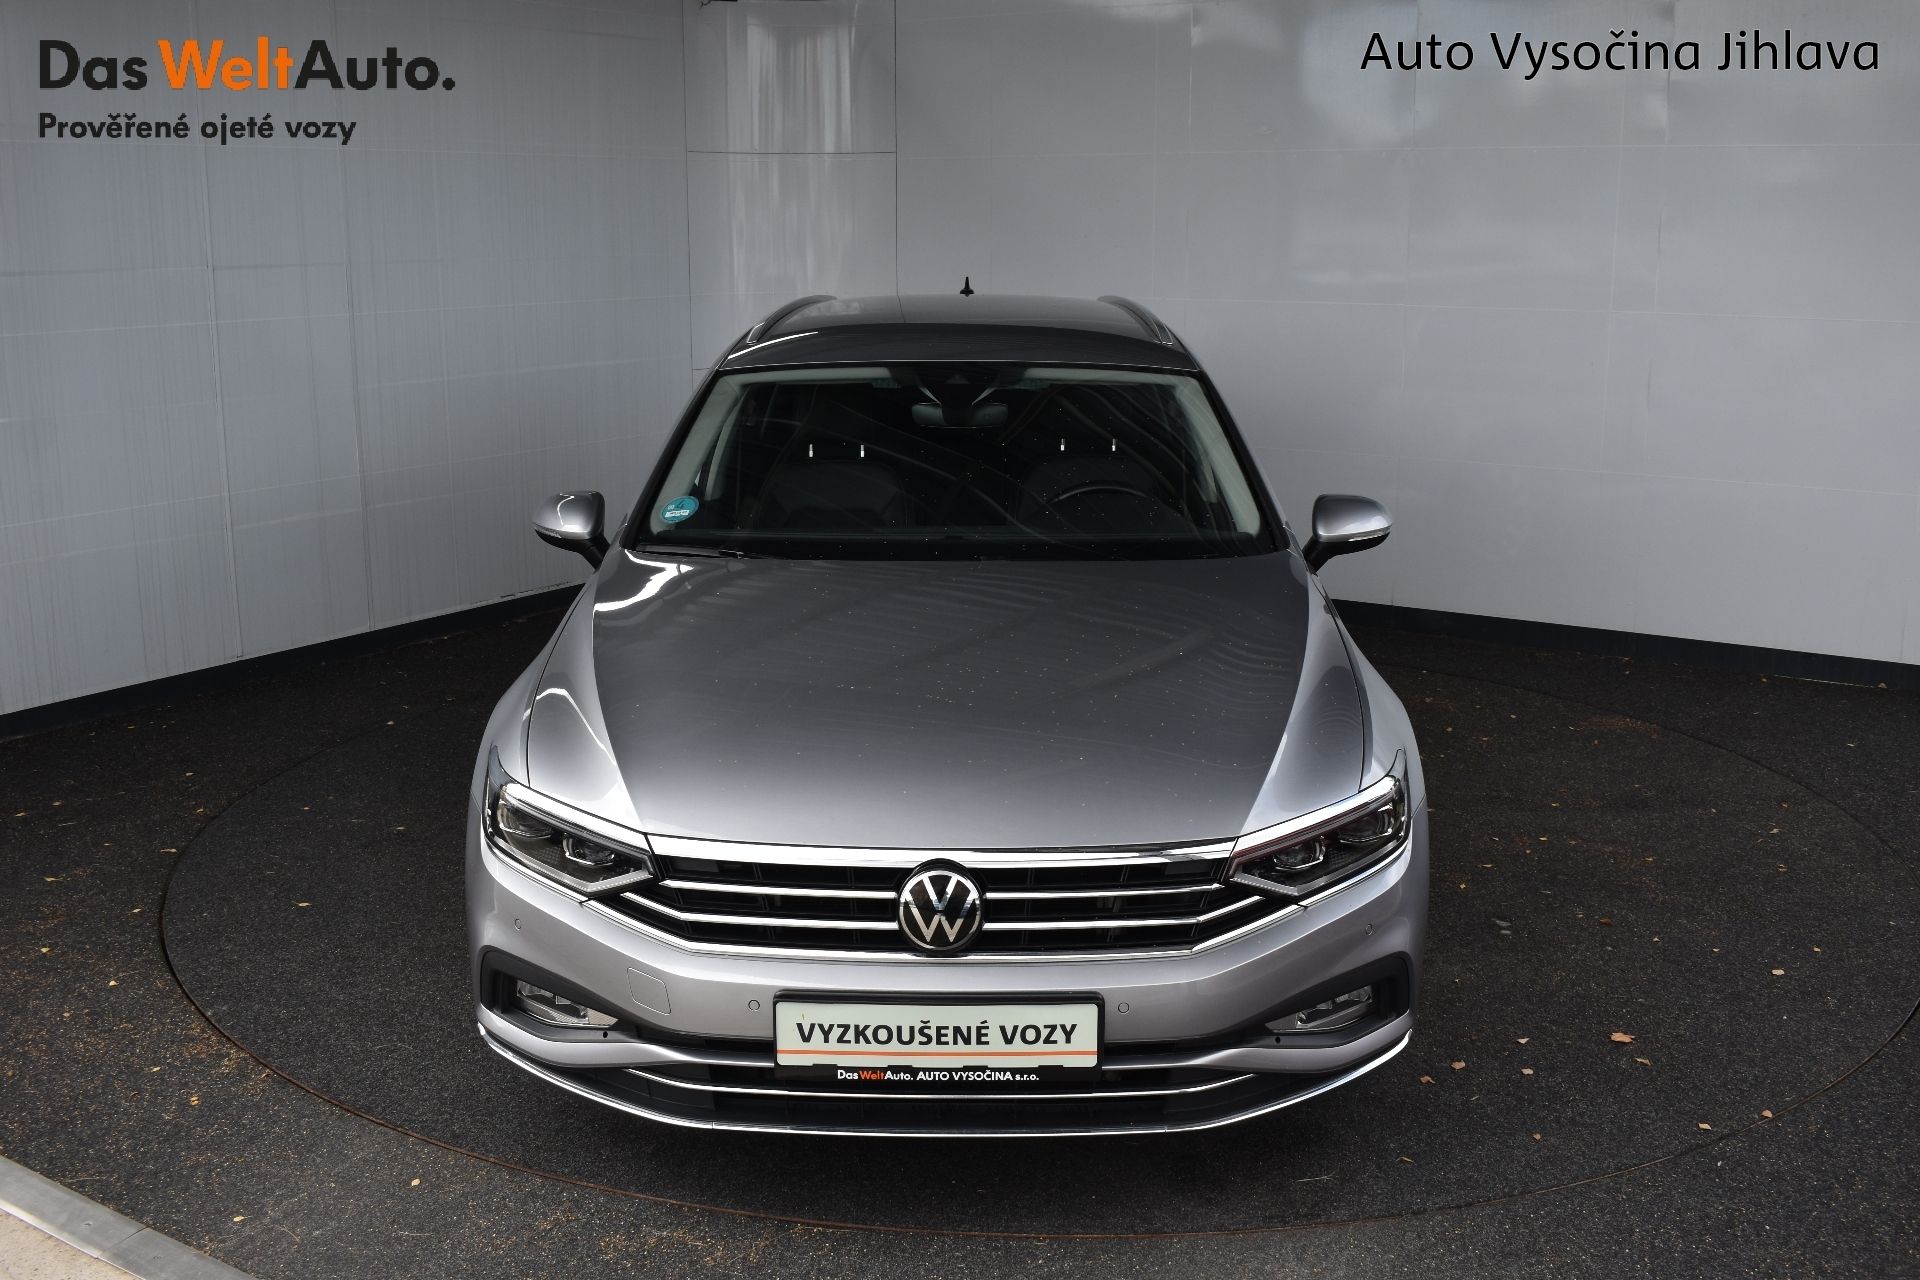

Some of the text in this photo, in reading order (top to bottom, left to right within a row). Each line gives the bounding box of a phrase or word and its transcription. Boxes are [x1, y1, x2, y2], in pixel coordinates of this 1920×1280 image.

[796, 1020, 1078, 1046] VYZKOUŠENÉ VOZY
[917, 1071, 950, 1082] AUTO
[952, 1068, 1013, 1082] VYSOČINA
[1015, 1073, 1040, 1081] s.r.o.
